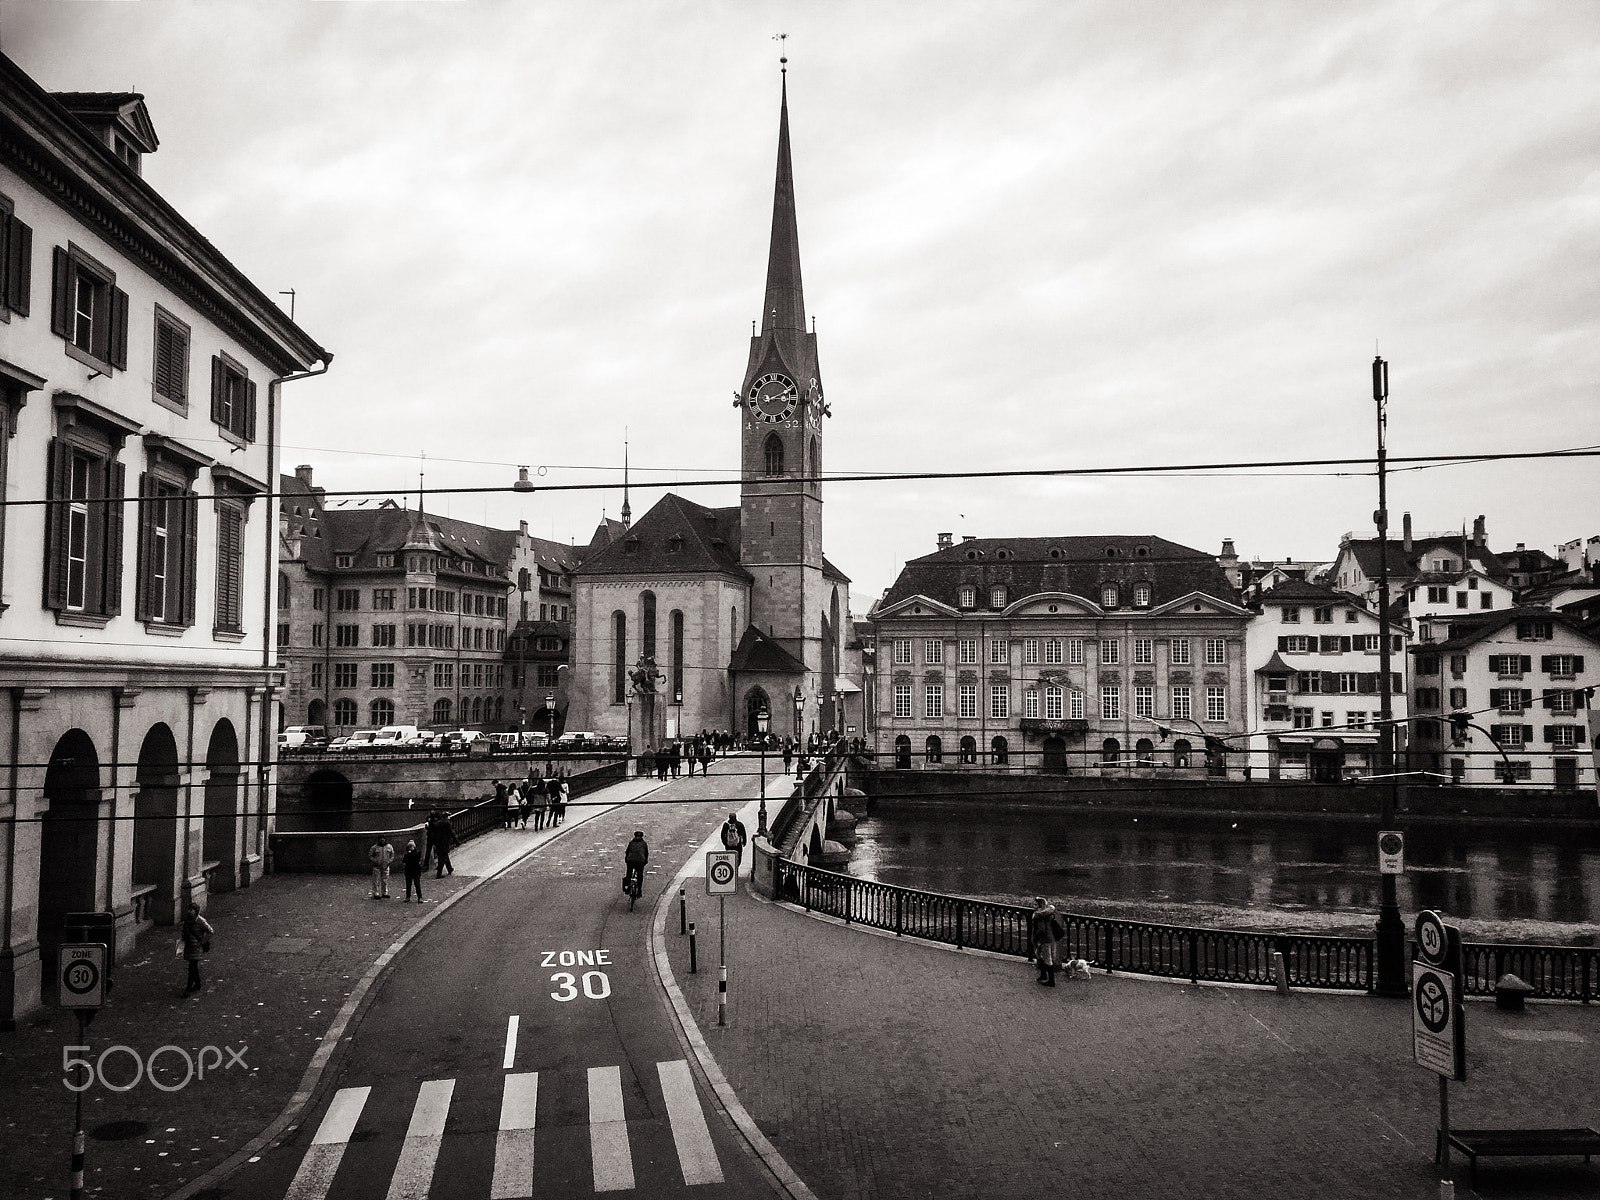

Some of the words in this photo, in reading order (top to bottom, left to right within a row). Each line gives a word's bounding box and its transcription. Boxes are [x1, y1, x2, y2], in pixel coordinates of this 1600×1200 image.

[717, 868, 728, 878] 30
[1424, 927, 1437, 948] 30
[71, 950, 93, 959] ZONE
[540, 949, 613, 968] ZONE
[72, 969, 90, 984] 30
[550, 970, 612, 1002] 30
